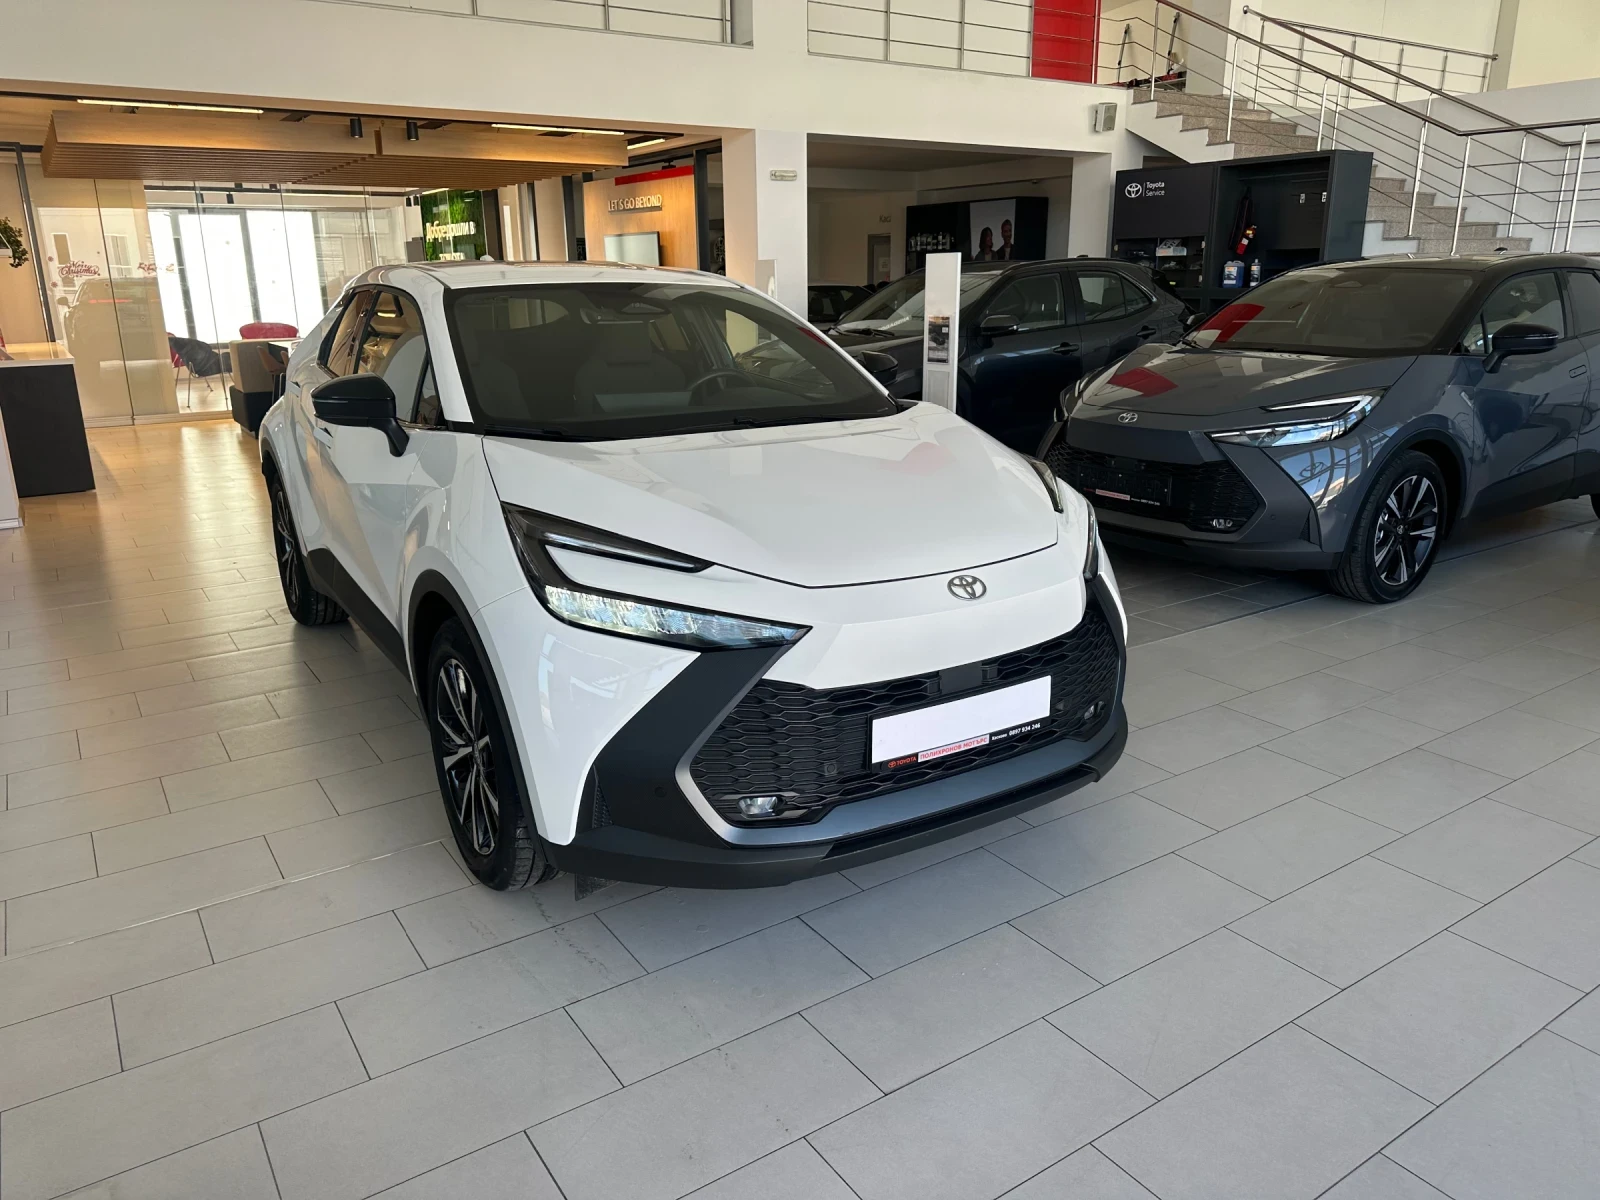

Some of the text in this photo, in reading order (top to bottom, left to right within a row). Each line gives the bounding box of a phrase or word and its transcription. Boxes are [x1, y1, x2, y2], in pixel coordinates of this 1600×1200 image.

[1145, 181, 1165, 190] Toyota
[1145, 189, 1166, 197] Service
[624, 198, 635, 210] GO
[635, 194, 662, 208] BEYOND
[920, 737, 988, 759] ПОЛИХРОНОВ МОТЪРС
[896, 756, 917, 765] TOYOTA
